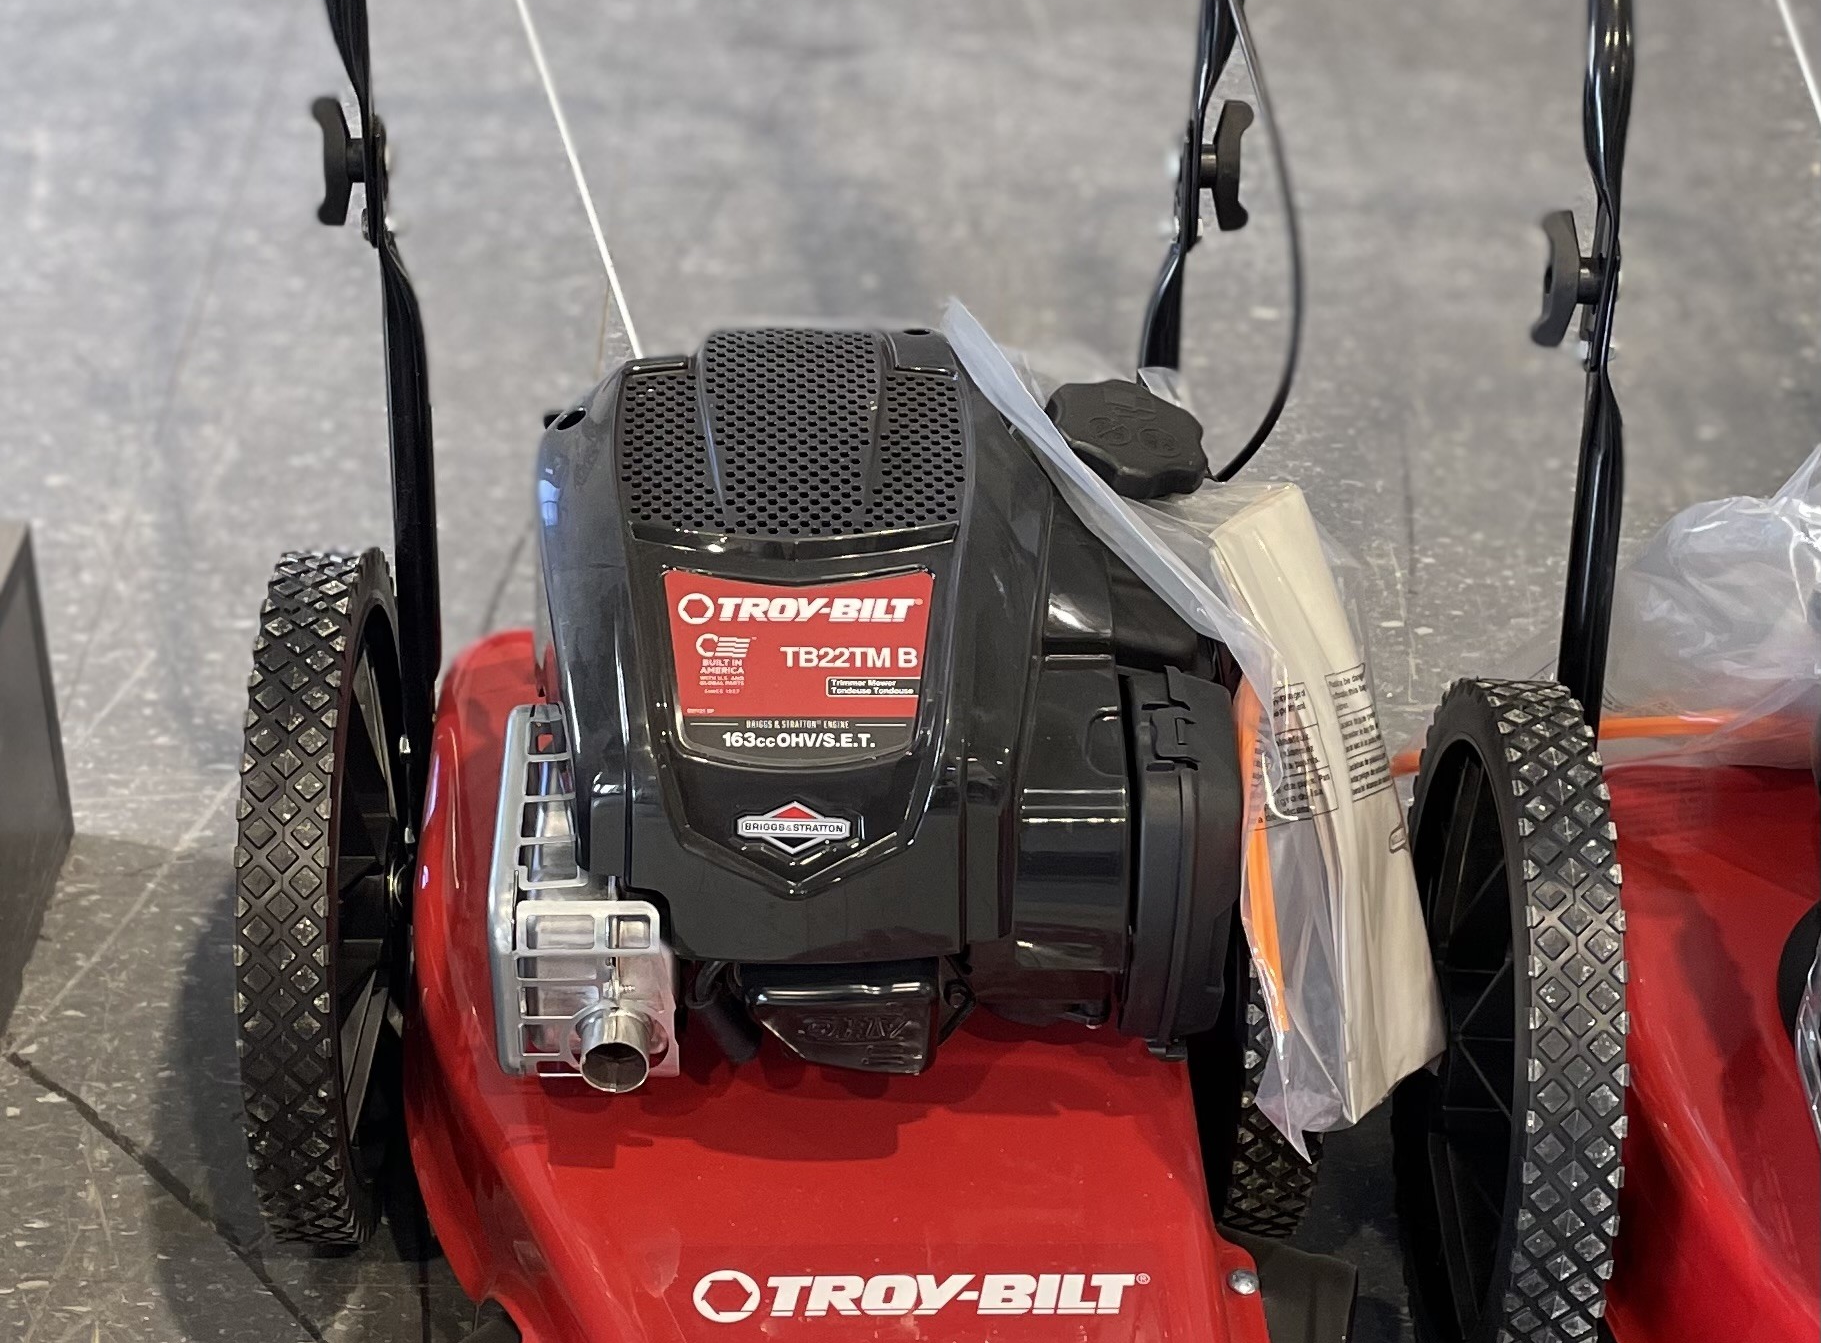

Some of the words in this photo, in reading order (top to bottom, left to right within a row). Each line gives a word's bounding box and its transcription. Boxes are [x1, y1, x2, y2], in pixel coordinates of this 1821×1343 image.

[717, 597, 915, 622] TROY-BILT
[702, 659, 730, 667] BUILT
[732, 659, 742, 667] IN
[780, 646, 891, 668] TB22TM
[898, 647, 918, 668] B
[700, 667, 744, 675] AMERICA
[746, 720, 772, 728] BRIGGS
[823, 720, 849, 729] ENGINE
[767, 1273, 1137, 1317] TROY-BILT
